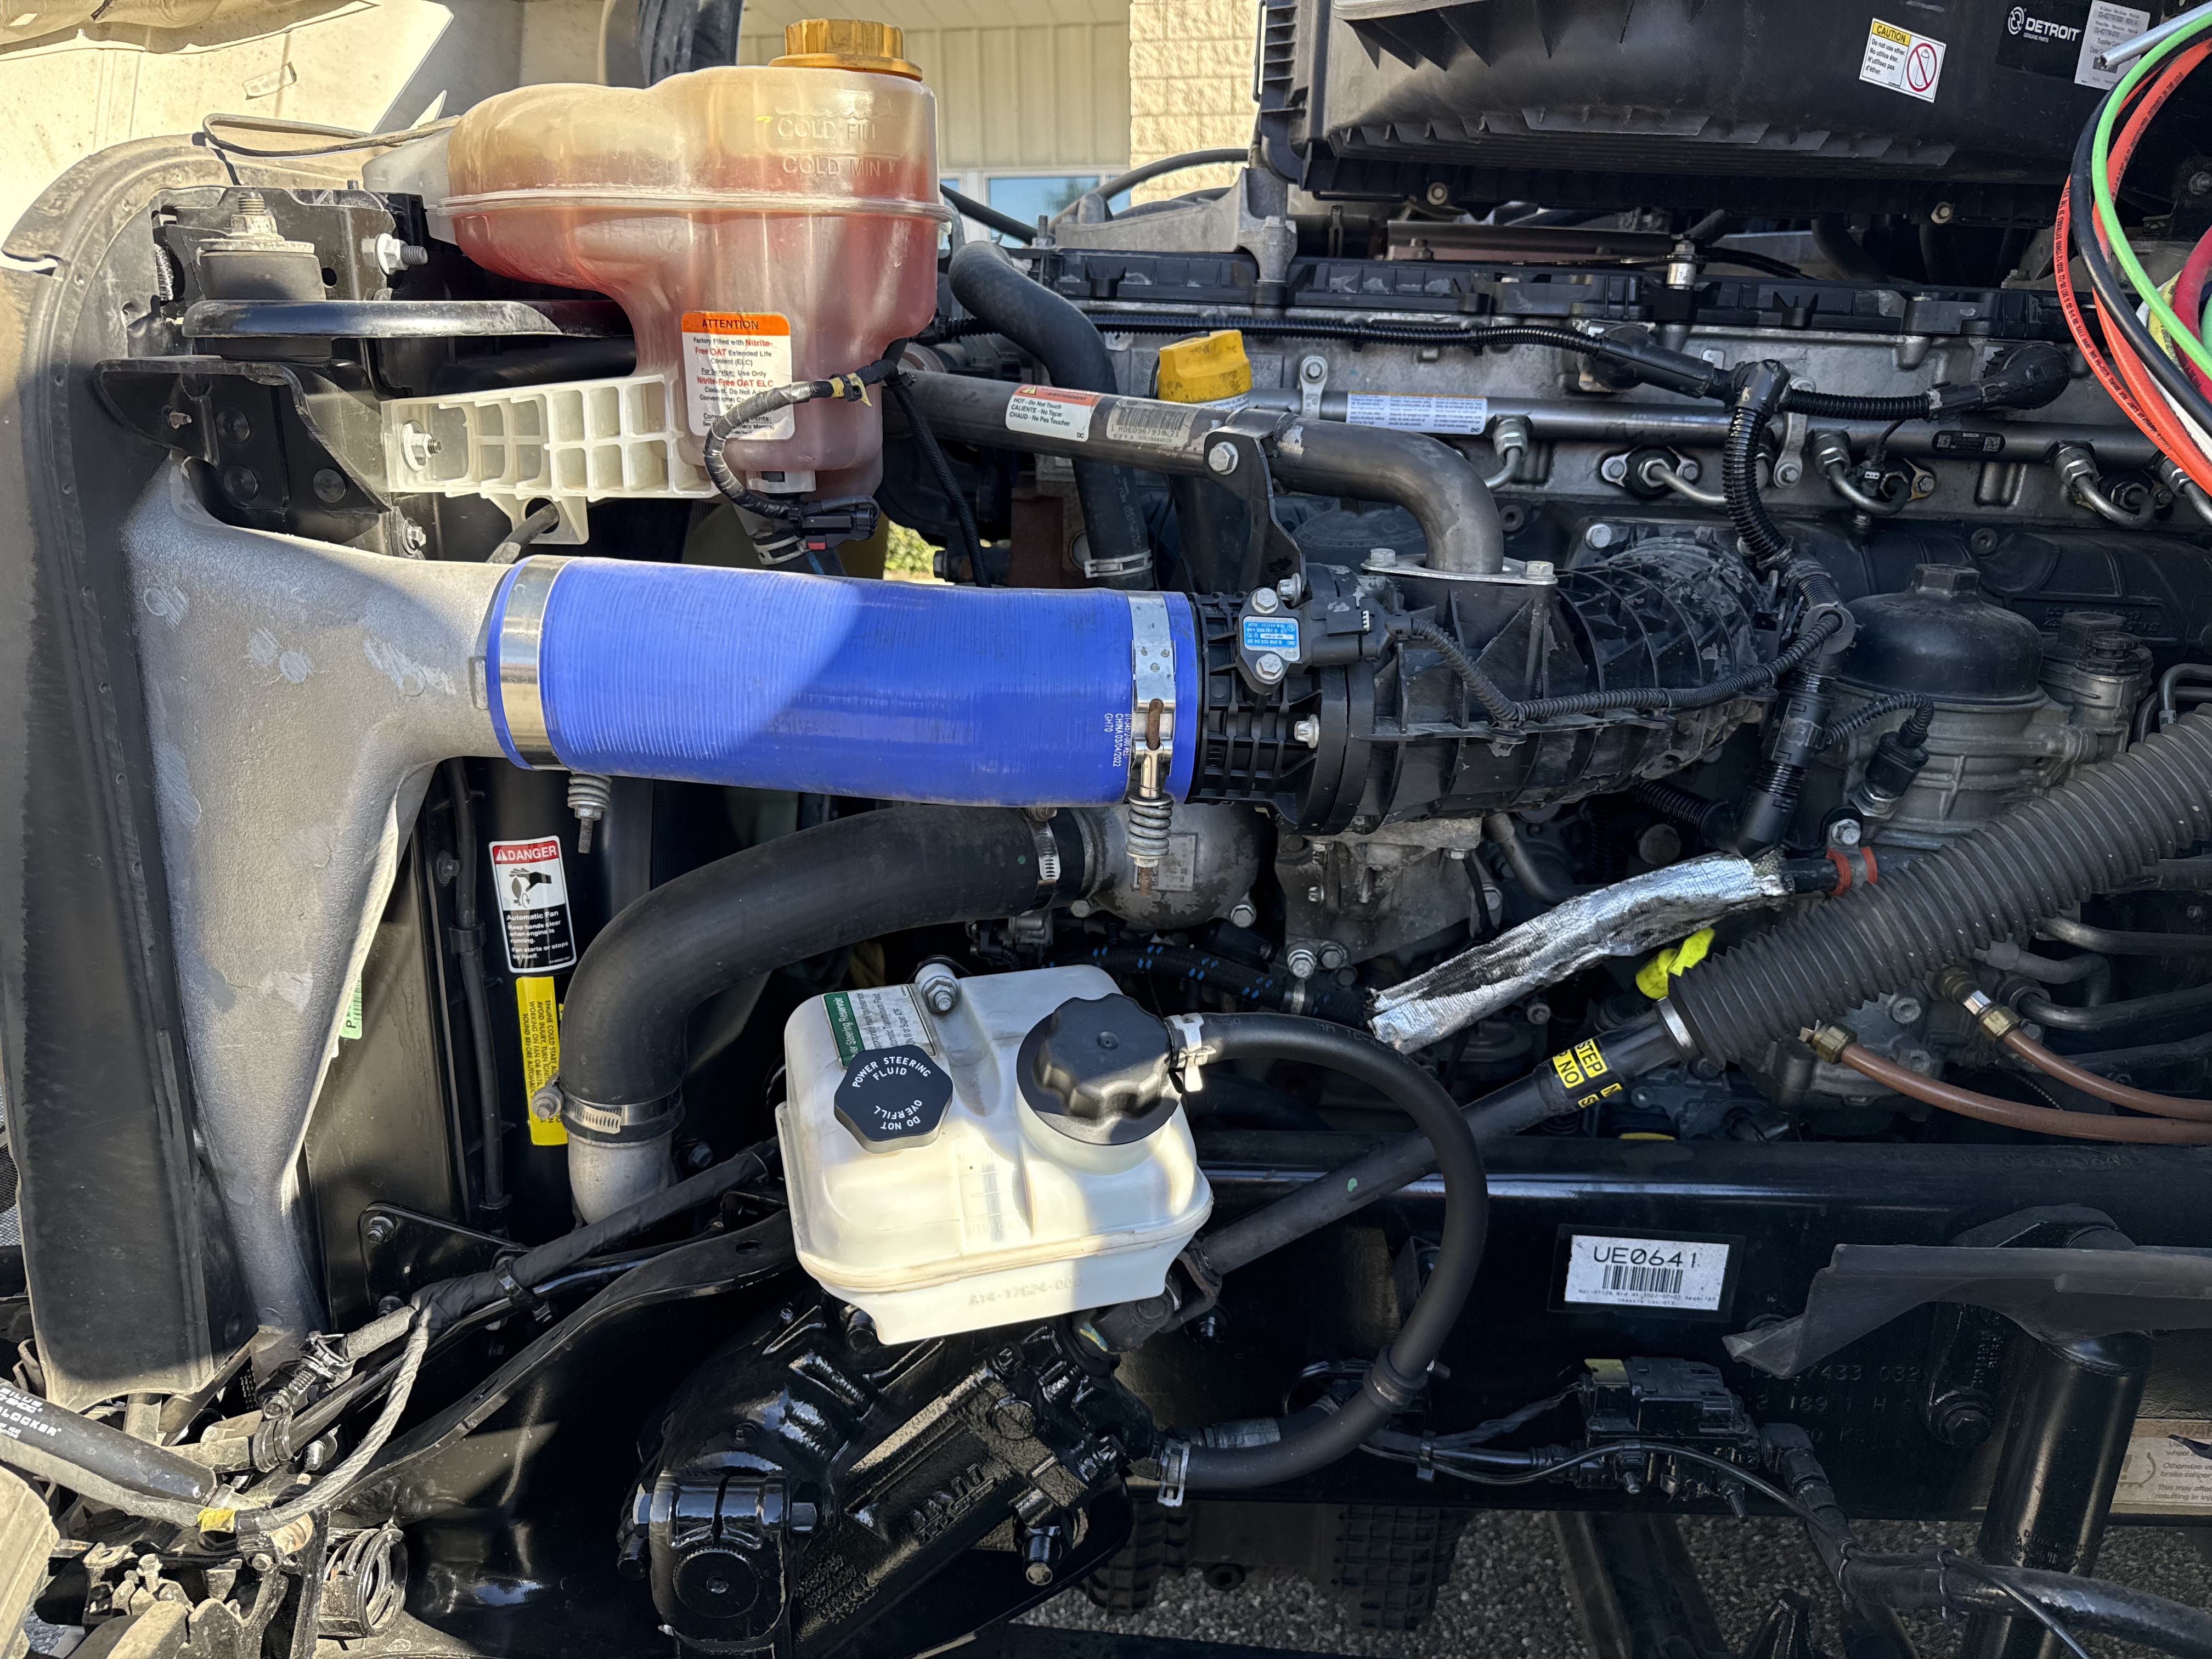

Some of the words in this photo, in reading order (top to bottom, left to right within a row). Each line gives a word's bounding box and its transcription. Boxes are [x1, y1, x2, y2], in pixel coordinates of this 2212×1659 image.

[1877, 25, 1906, 43] CAUTION
[2025, 18, 2080, 41] DETROIT
[778, 119, 834, 139] COLD
[783, 156, 840, 176] COLD
[851, 159, 880, 177] MIN
[702, 319, 758, 329] ATTENTION
[1104, 713, 1113, 732] GH70
[1115, 714, 1123, 734] CHINA
[1113, 735, 1123, 767] 03/04/2022
[508, 845, 557, 861] DANGER
[507, 912, 543, 921] Automatic
[551, 941, 568, 950] stops
[529, 1001, 537, 1032] WORKING
[833, 997, 849, 1022] Reservoir
[533, 1033, 538, 1043] ON
[841, 1022, 856, 1048] Steering
[535, 1059, 541, 1069] OR
[1577, 1040, 1603, 1073] STEP
[527, 1060, 536, 1094] AUTOMATIC
[852, 1061, 878, 1087] POWER
[883, 1056, 930, 1077] STEERING
[873, 1067, 907, 1080] FLUID
[1558, 1060, 1579, 1084] NO
[874, 1099, 922, 1120] OVERFILL
[881, 1122, 901, 1130] NOT
[907, 1115, 921, 1127] DO
[1594, 1246, 1696, 1268] UE0641
